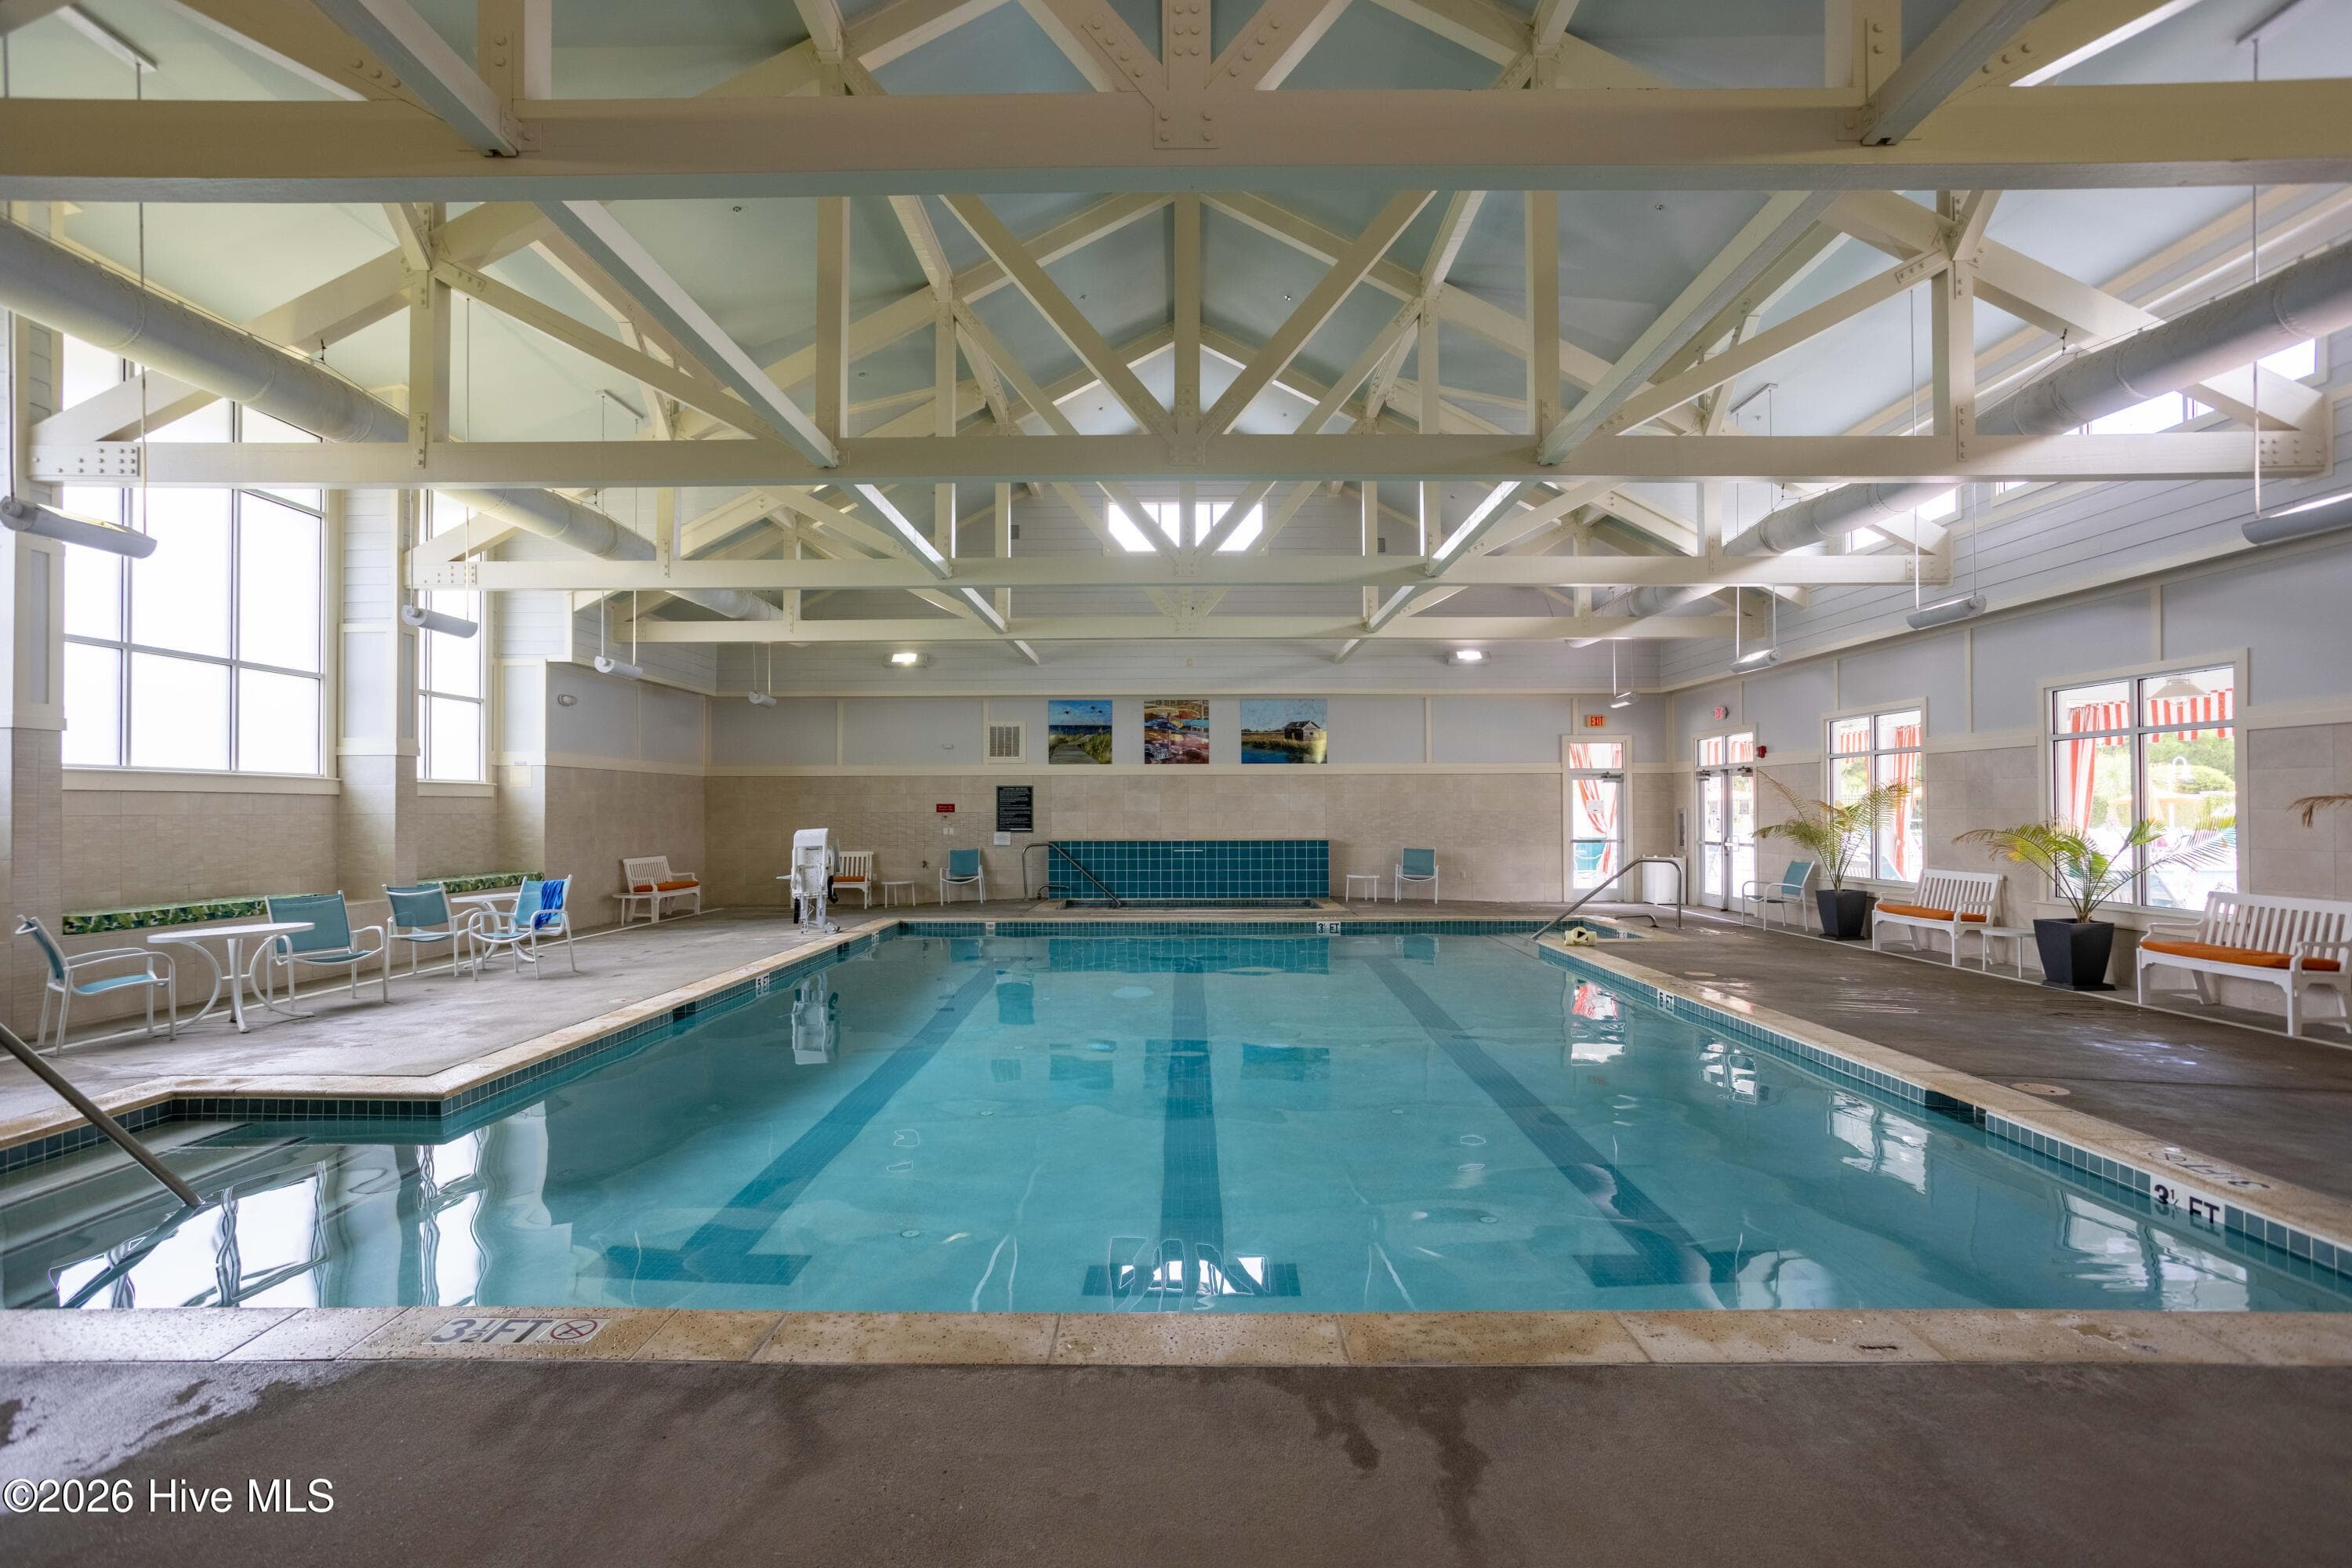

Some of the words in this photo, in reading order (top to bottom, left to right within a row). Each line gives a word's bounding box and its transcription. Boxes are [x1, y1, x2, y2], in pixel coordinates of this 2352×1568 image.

[1591, 716, 1604, 726] EXIT
[2189, 1196, 2220, 1224] FT
[481, 1319, 554, 1343] FT
